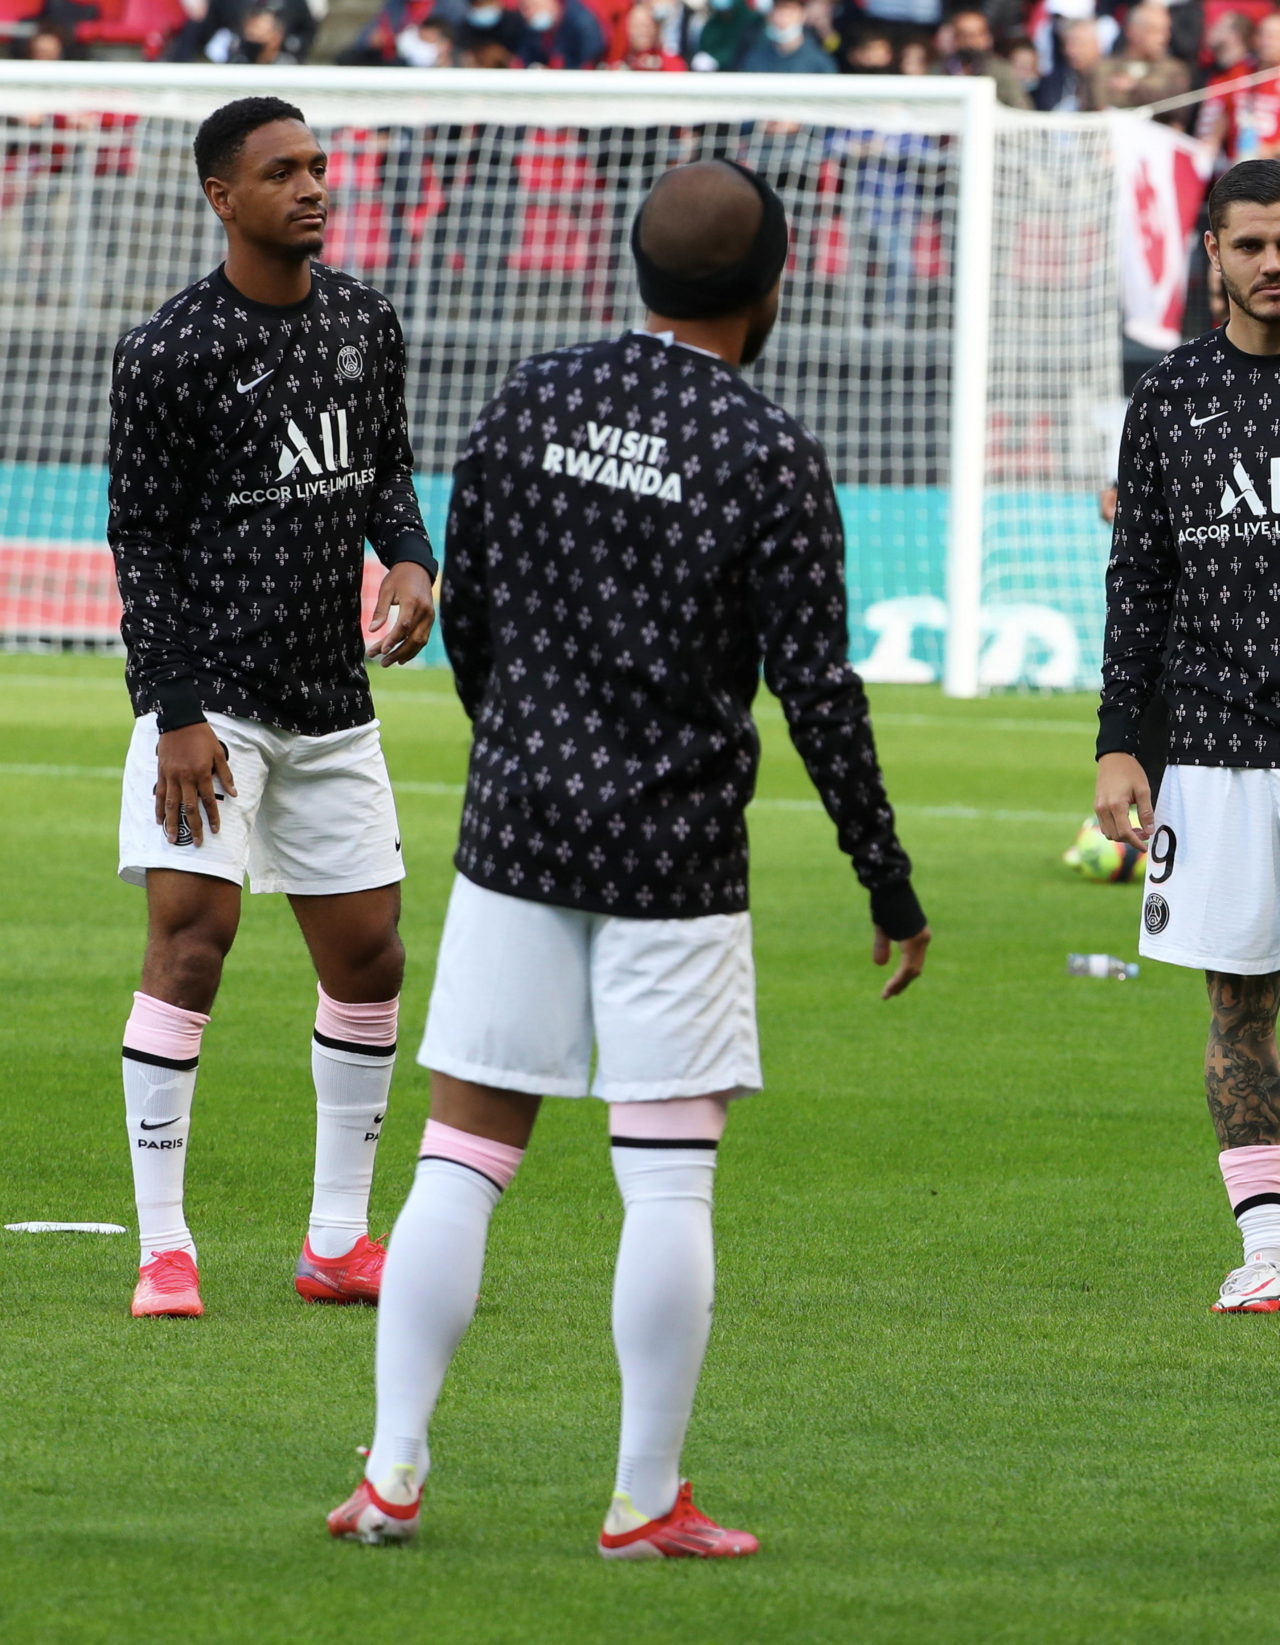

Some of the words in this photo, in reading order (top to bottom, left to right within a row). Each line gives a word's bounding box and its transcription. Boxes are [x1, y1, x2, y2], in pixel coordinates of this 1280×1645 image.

[586, 420, 667, 465] VISIT
[541, 442, 682, 503] RWANDA
[228, 486, 293, 505] ACCOR
[296, 478, 327, 499] LIVE
[1178, 524, 1230, 543] ACCOR
[1234, 520, 1270, 537] LIVE
[1149, 824, 1177, 884] 9
[138, 1138, 183, 1150] PARIS
